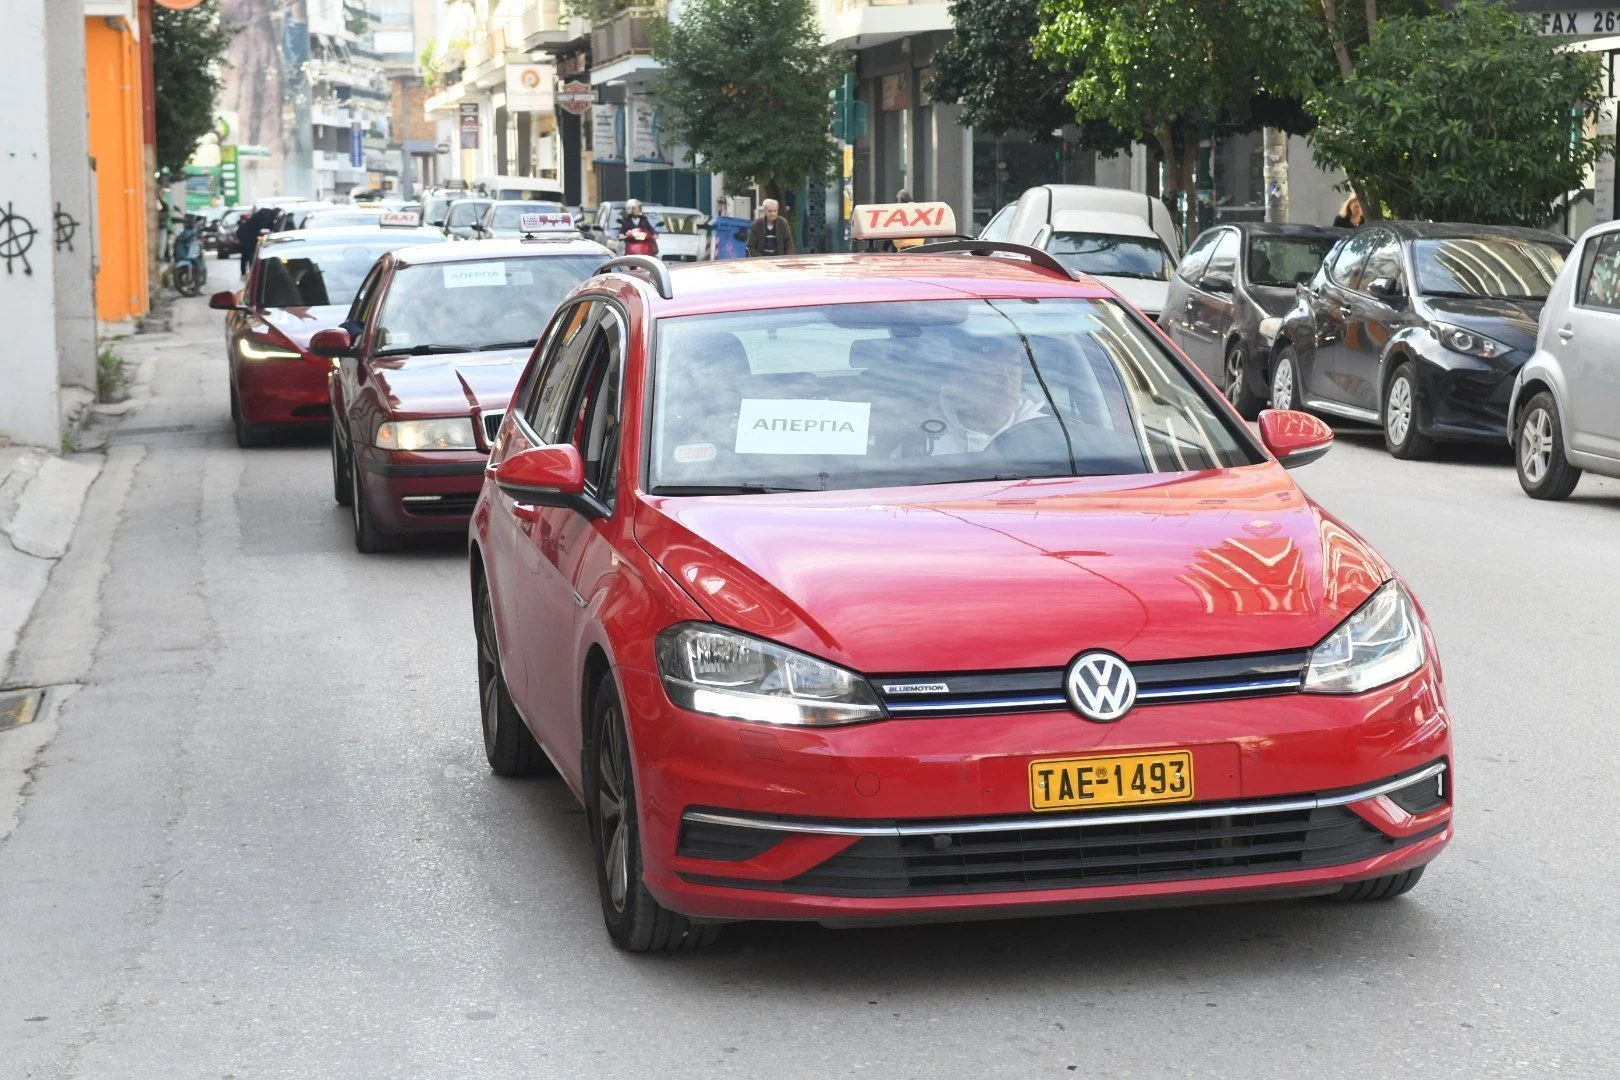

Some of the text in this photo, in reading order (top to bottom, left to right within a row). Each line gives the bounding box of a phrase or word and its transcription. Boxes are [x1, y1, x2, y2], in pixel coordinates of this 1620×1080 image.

[1541, 12, 1578, 33] FAX
[384, 213, 415, 222] TAXI
[866, 207, 945, 229] TAXI
[752, 417, 855, 433] ΑΠΕΡΓΙΑ
[888, 684, 944, 693] BLUEMOTION
[1070, 655, 1135, 718] VW
[1038, 760, 1185, 801] TAE-1493
